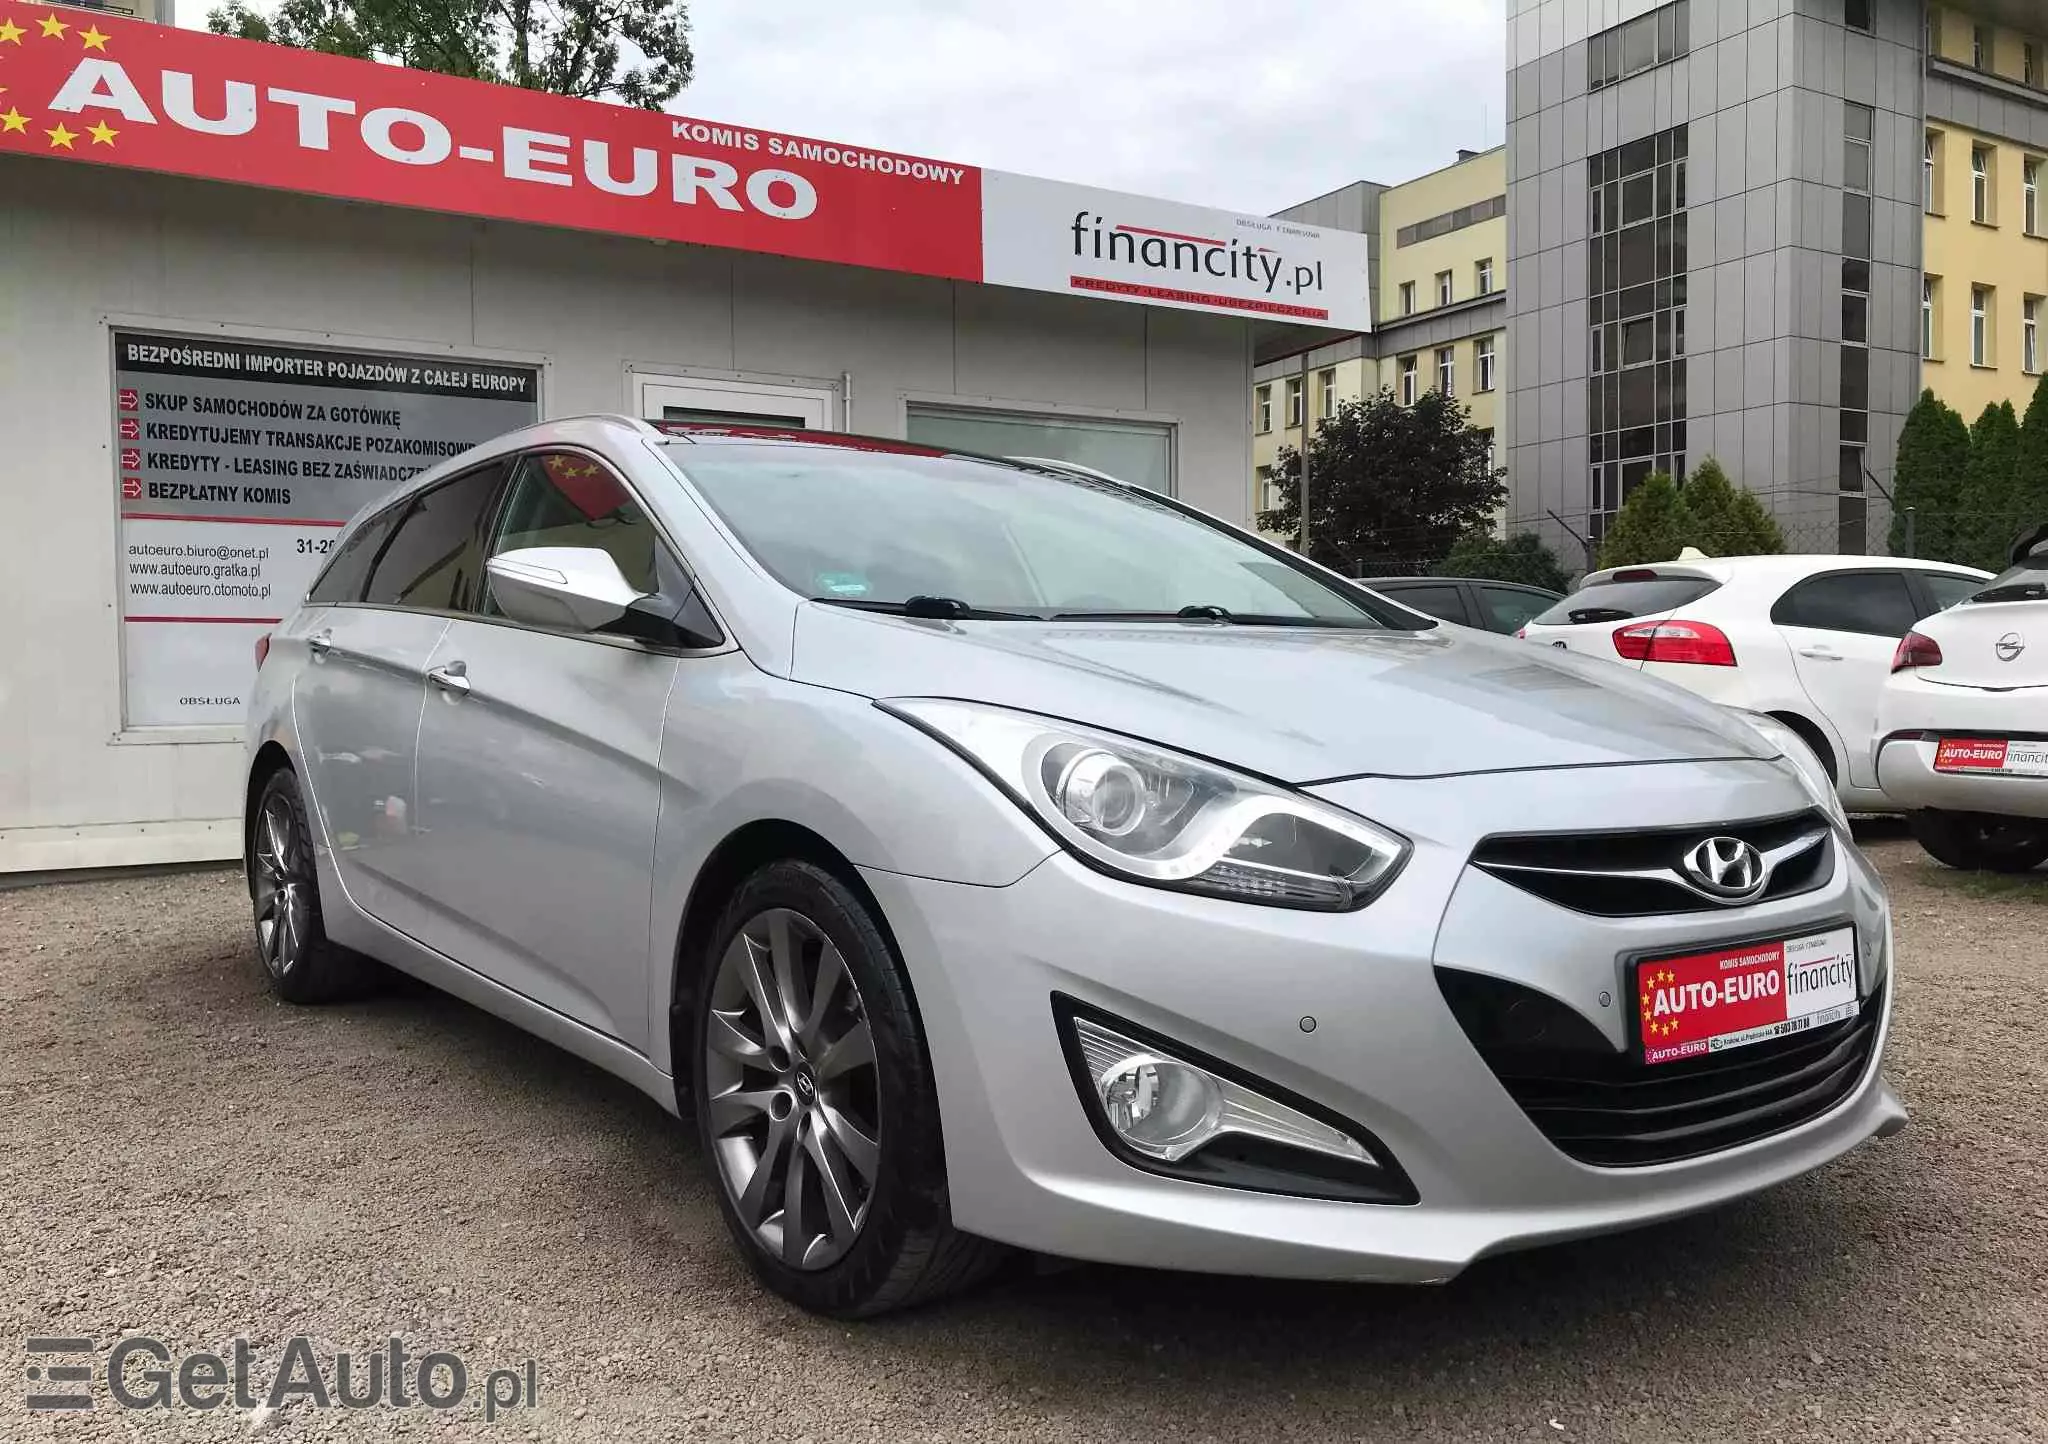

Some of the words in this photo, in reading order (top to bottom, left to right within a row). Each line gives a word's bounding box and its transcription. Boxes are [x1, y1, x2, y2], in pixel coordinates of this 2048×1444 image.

[48, 57, 818, 220] AUTO-EURO
[672, 121, 759, 151] KOMIS
[768, 137, 965, 185] SAMOCHODOWY
[1072, 211, 1322, 295] financity.pl
[127, 343, 240, 370] BEZPOŚREDNI
[246, 354, 324, 377] IMPORTER
[327, 362, 408, 384] POJAZDÓW
[411, 368, 421, 385] Z
[424, 369, 468, 389] CAŁEJ
[472, 373, 526, 393] EUROPY
[145, 392, 188, 412] SKUP
[193, 396, 302, 419] SAMOCHODÓW
[307, 404, 327, 421] ZA
[331, 405, 401, 430] GOTÓWKĘ
[146, 423, 262, 446] KREDYTUJEMY
[266, 430, 362, 452] TRANSAKCJE
[147, 452, 220, 473] KREDYTY
[234, 457, 298, 477] LEASING
[302, 461, 331, 478] BEZ
[148, 482, 239, 503] BEZPŁATNY
[243, 487, 291, 505] KOMIS
[128, 544, 269, 561] autoeuro.biuro@onet.pl
[130, 562, 261, 580] www.autoeuro.gratka.pl
[130, 581, 271, 600] www.autoeuro.otomoto.pl
[179, 696, 241, 706] OBSŁUGA
[1943, 748, 2003, 760] AUTO-EURO
[1653, 969, 1780, 1017] AUTO-EURO
[1786, 953, 1853, 996] financity
[1652, 1042, 1706, 1060] AUTO-EURO
